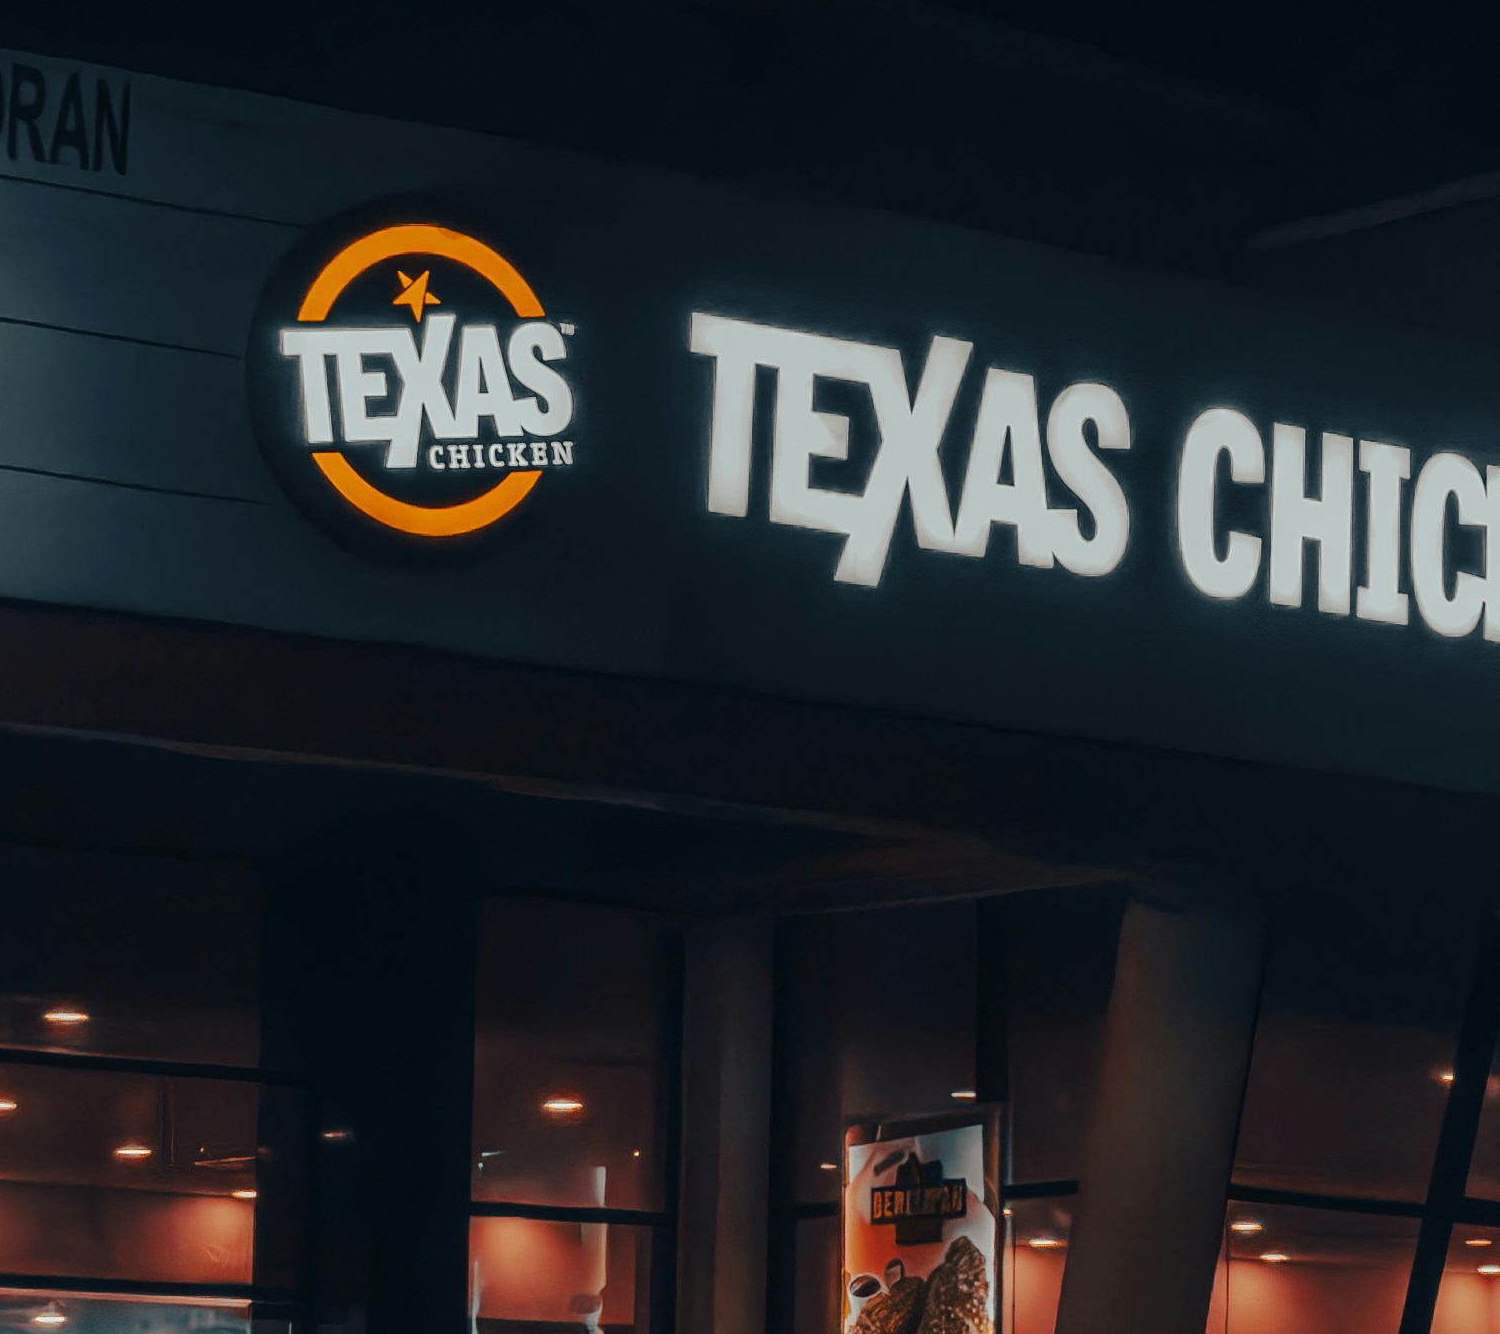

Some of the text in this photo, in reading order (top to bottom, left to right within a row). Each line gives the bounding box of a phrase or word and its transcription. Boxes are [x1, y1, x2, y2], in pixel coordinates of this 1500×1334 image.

[280, 315, 573, 468] TEXAS
[429, 441, 574, 470] CHICKEN
[692, 312, 1130, 588] TEXAS
